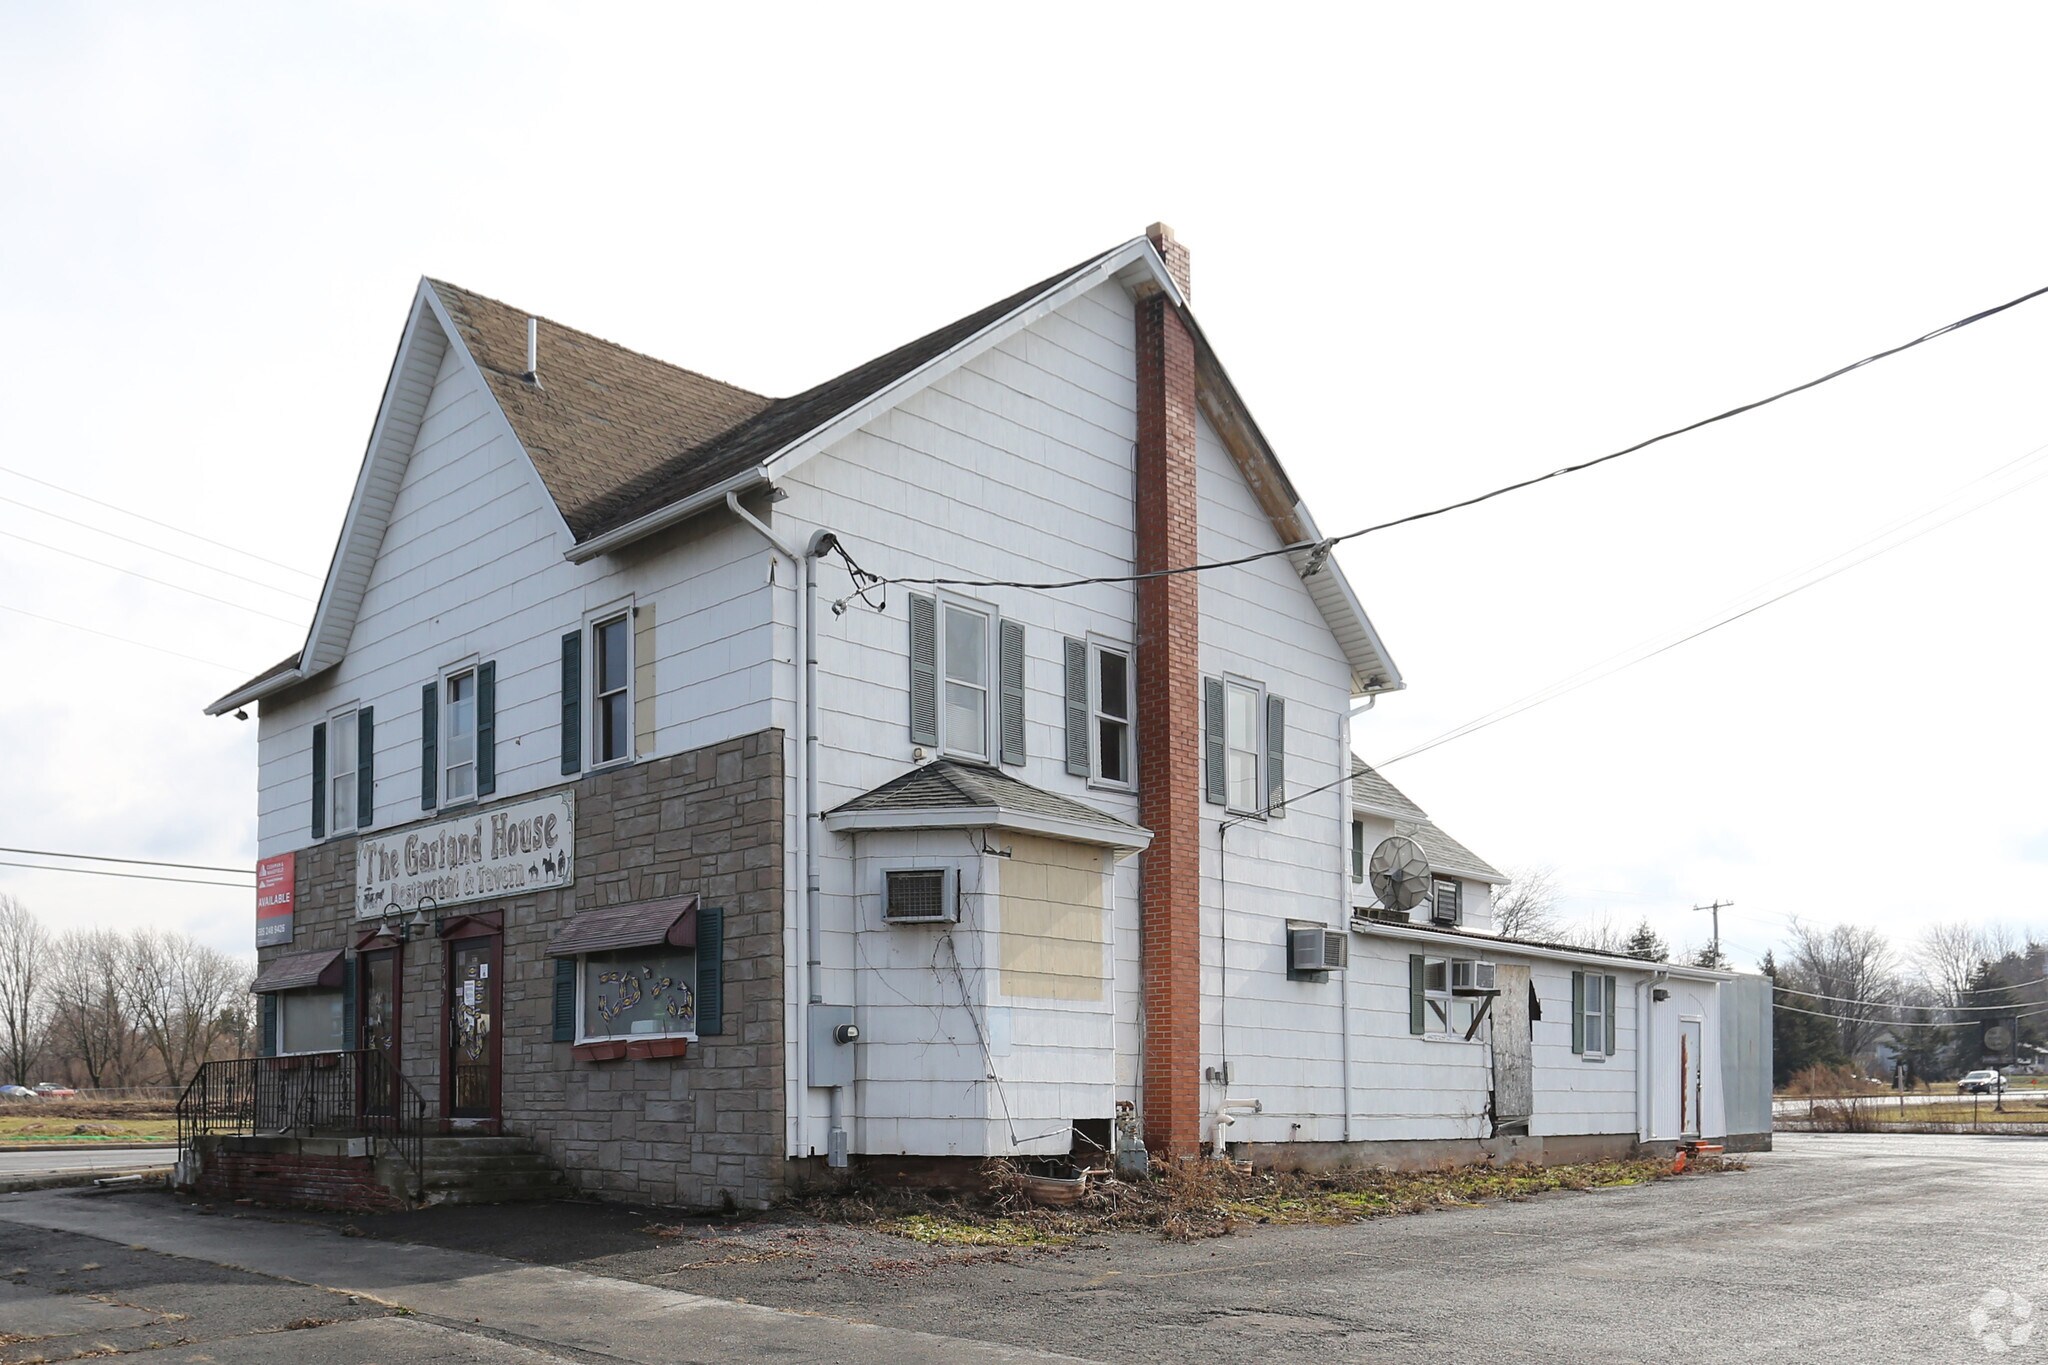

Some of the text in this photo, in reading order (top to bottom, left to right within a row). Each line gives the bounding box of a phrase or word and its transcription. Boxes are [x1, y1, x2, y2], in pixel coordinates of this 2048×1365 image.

[363, 812, 559, 884] The Garland House
[258, 892, 291, 908] AVAILABLE
[390, 862, 526, 908] Restaurant & Tavern
